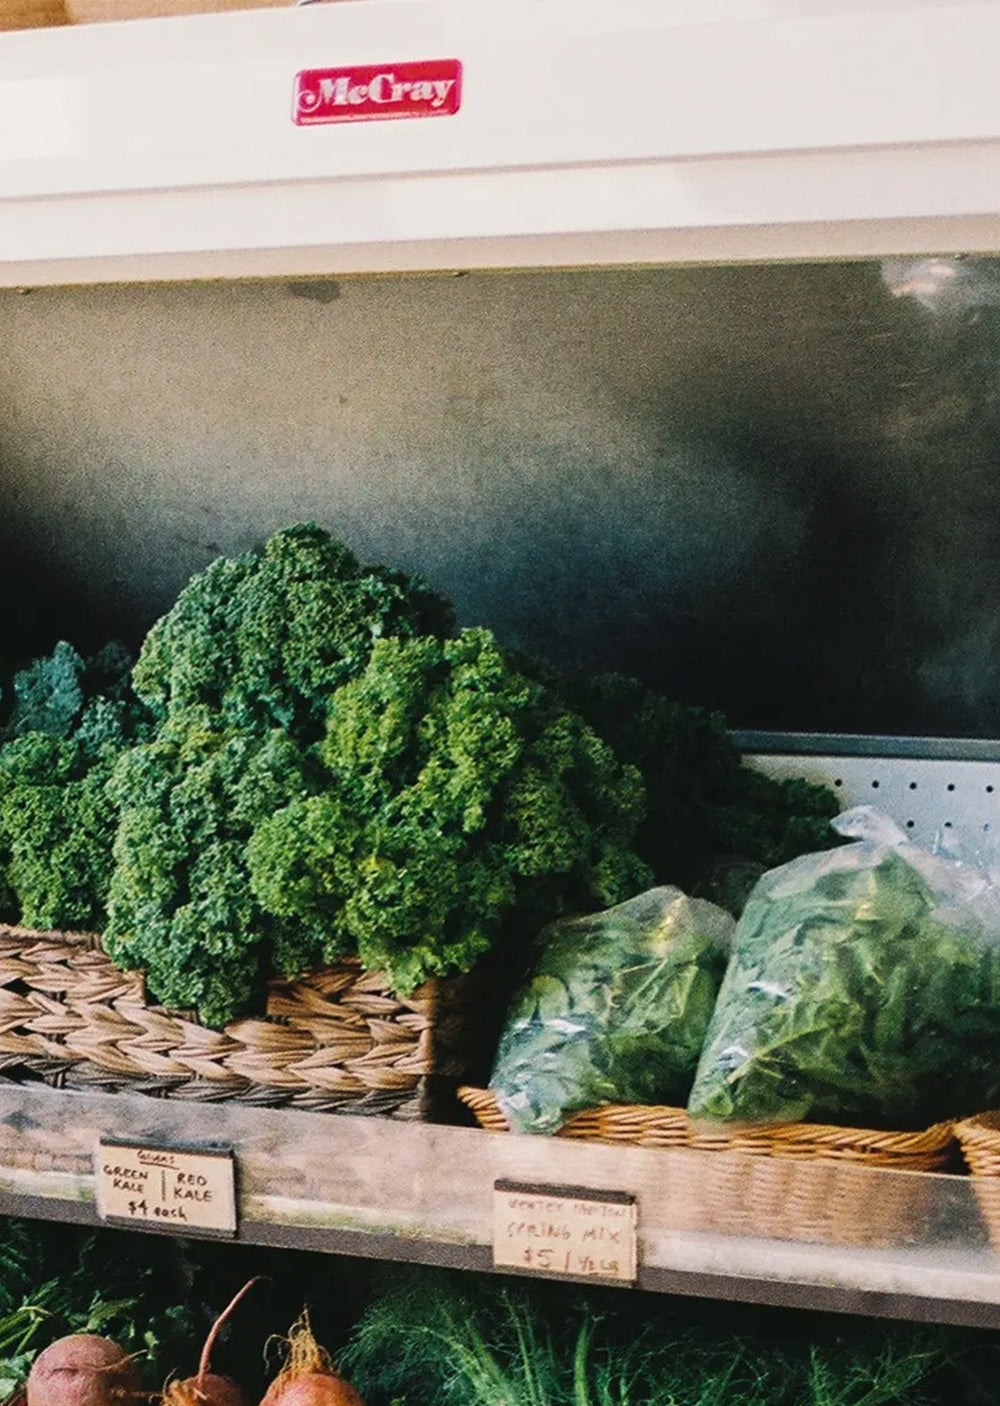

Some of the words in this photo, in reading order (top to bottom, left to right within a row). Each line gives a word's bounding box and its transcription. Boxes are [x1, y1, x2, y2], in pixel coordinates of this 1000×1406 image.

[299, 73, 455, 113] McCray
[103, 1165, 148, 1180] GREEN
[177, 1172, 207, 1187] RED
[113, 1178, 144, 1193] KALE
[174, 1187, 212, 1202] KALE
